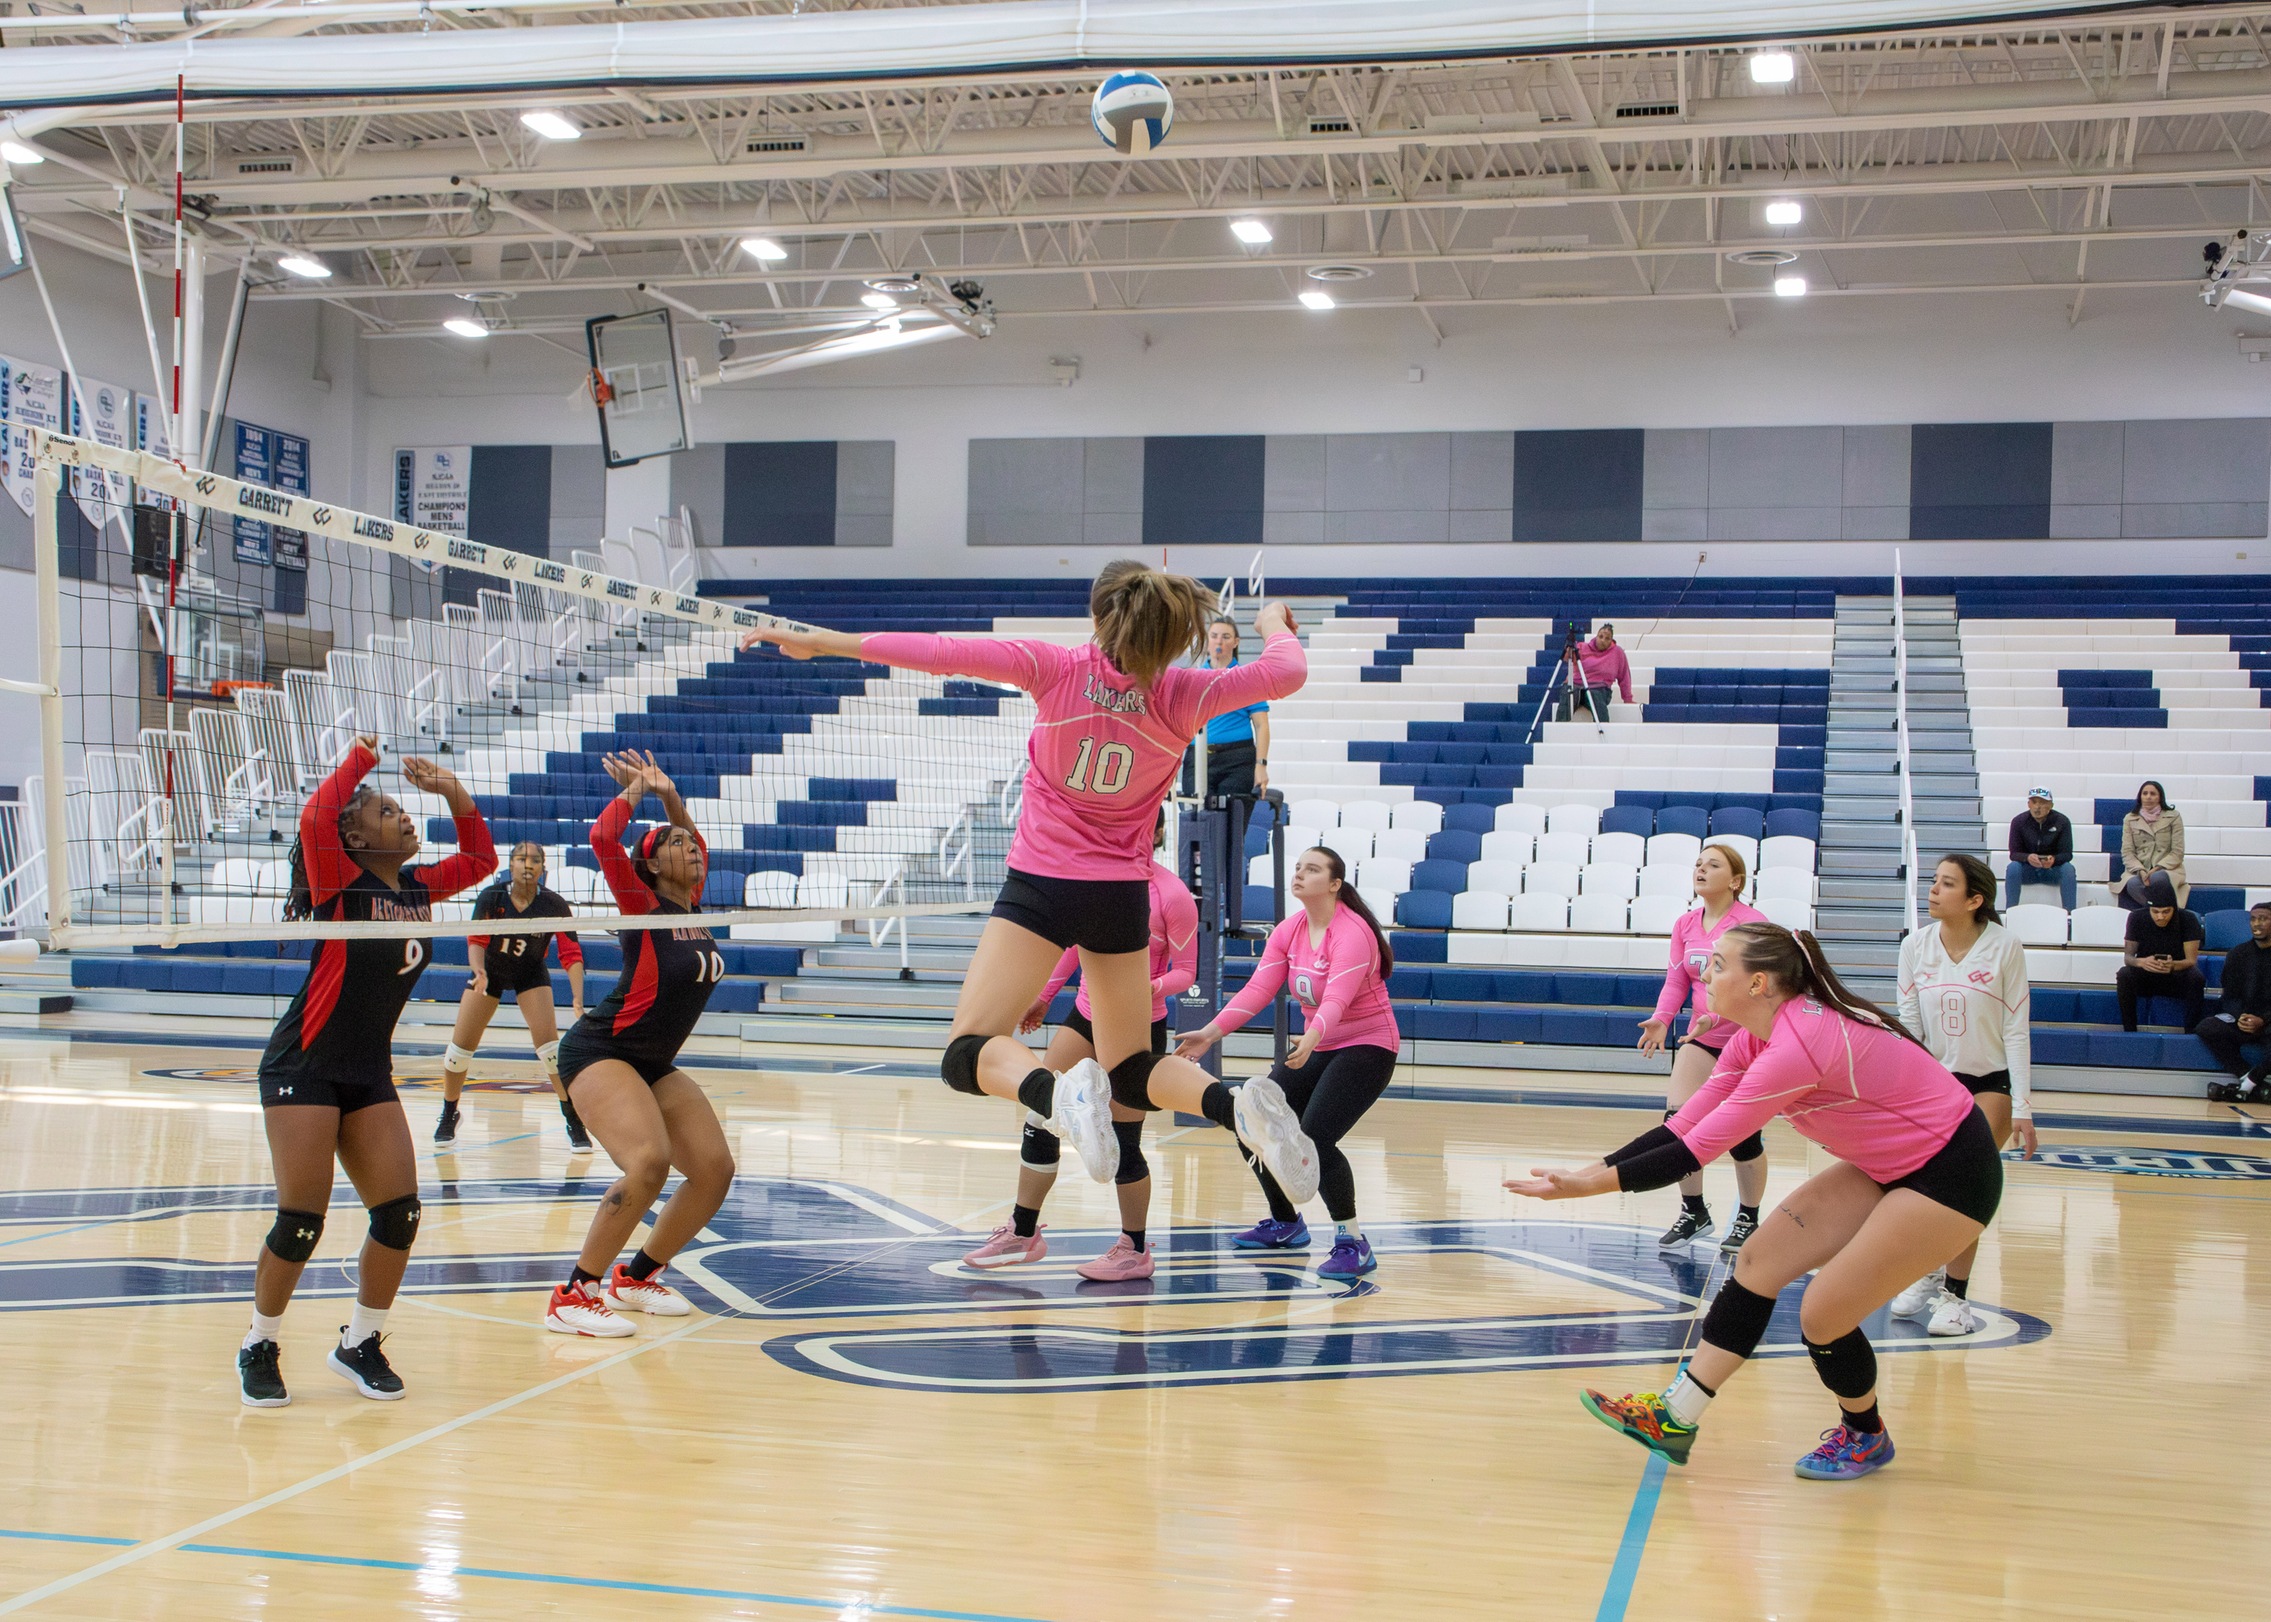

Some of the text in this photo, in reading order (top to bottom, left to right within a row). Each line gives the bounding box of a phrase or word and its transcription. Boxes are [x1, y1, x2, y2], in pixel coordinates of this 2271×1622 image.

[54, 436, 76, 447] Senoh
[398, 456, 410, 524] AKERS
[418, 502, 466, 511] CHAMPIONS
[239, 487, 293, 518] GARRETT
[353, 515, 394, 542] LAKERS
[447, 540, 487, 565] GARRETT
[430, 512, 453, 520] MENS
[1083, 673, 1146, 716] LAKERS
[1064, 736, 1135, 794] 10
[397, 938, 424, 976] 9
[500, 937, 528, 958] 13
[695, 950, 725, 983] 10
[1689, 954, 1709, 977] 7
[1295, 974, 1318, 1007] 9
[1940, 990, 1967, 1037] 8
